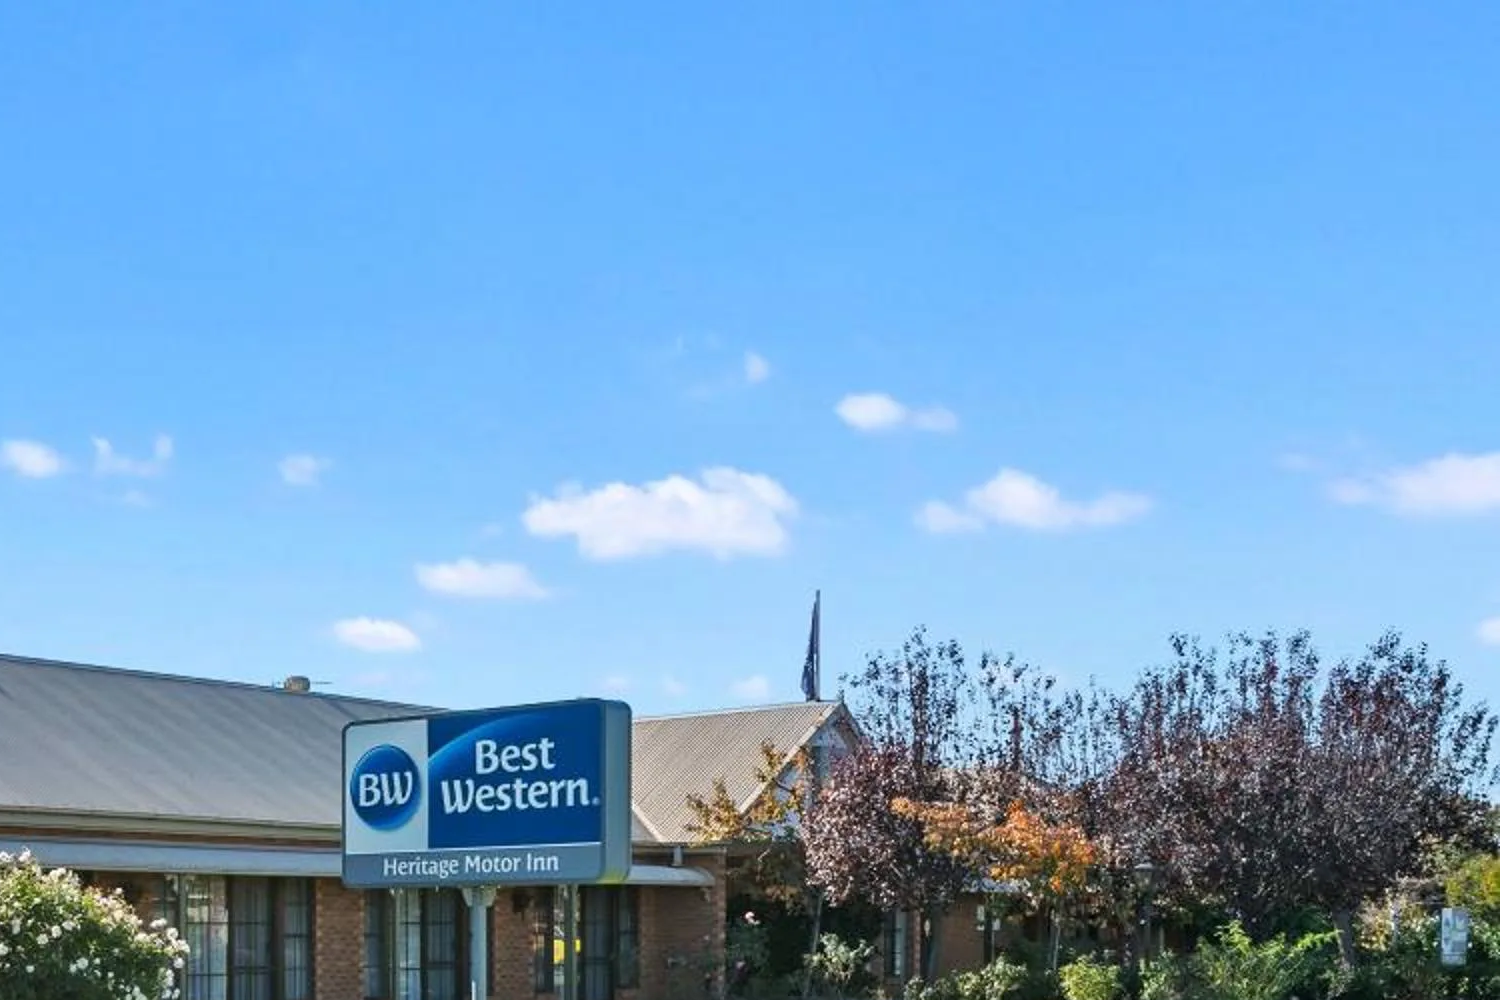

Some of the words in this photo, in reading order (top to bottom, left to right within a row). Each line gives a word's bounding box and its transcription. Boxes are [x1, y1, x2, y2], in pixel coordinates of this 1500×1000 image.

[475, 737, 556, 775] Best
[358, 770, 413, 807] BW
[383, 857, 459, 878] Heritage
[464, 853, 520, 874] Motor
[527, 852, 559, 872] Inn
